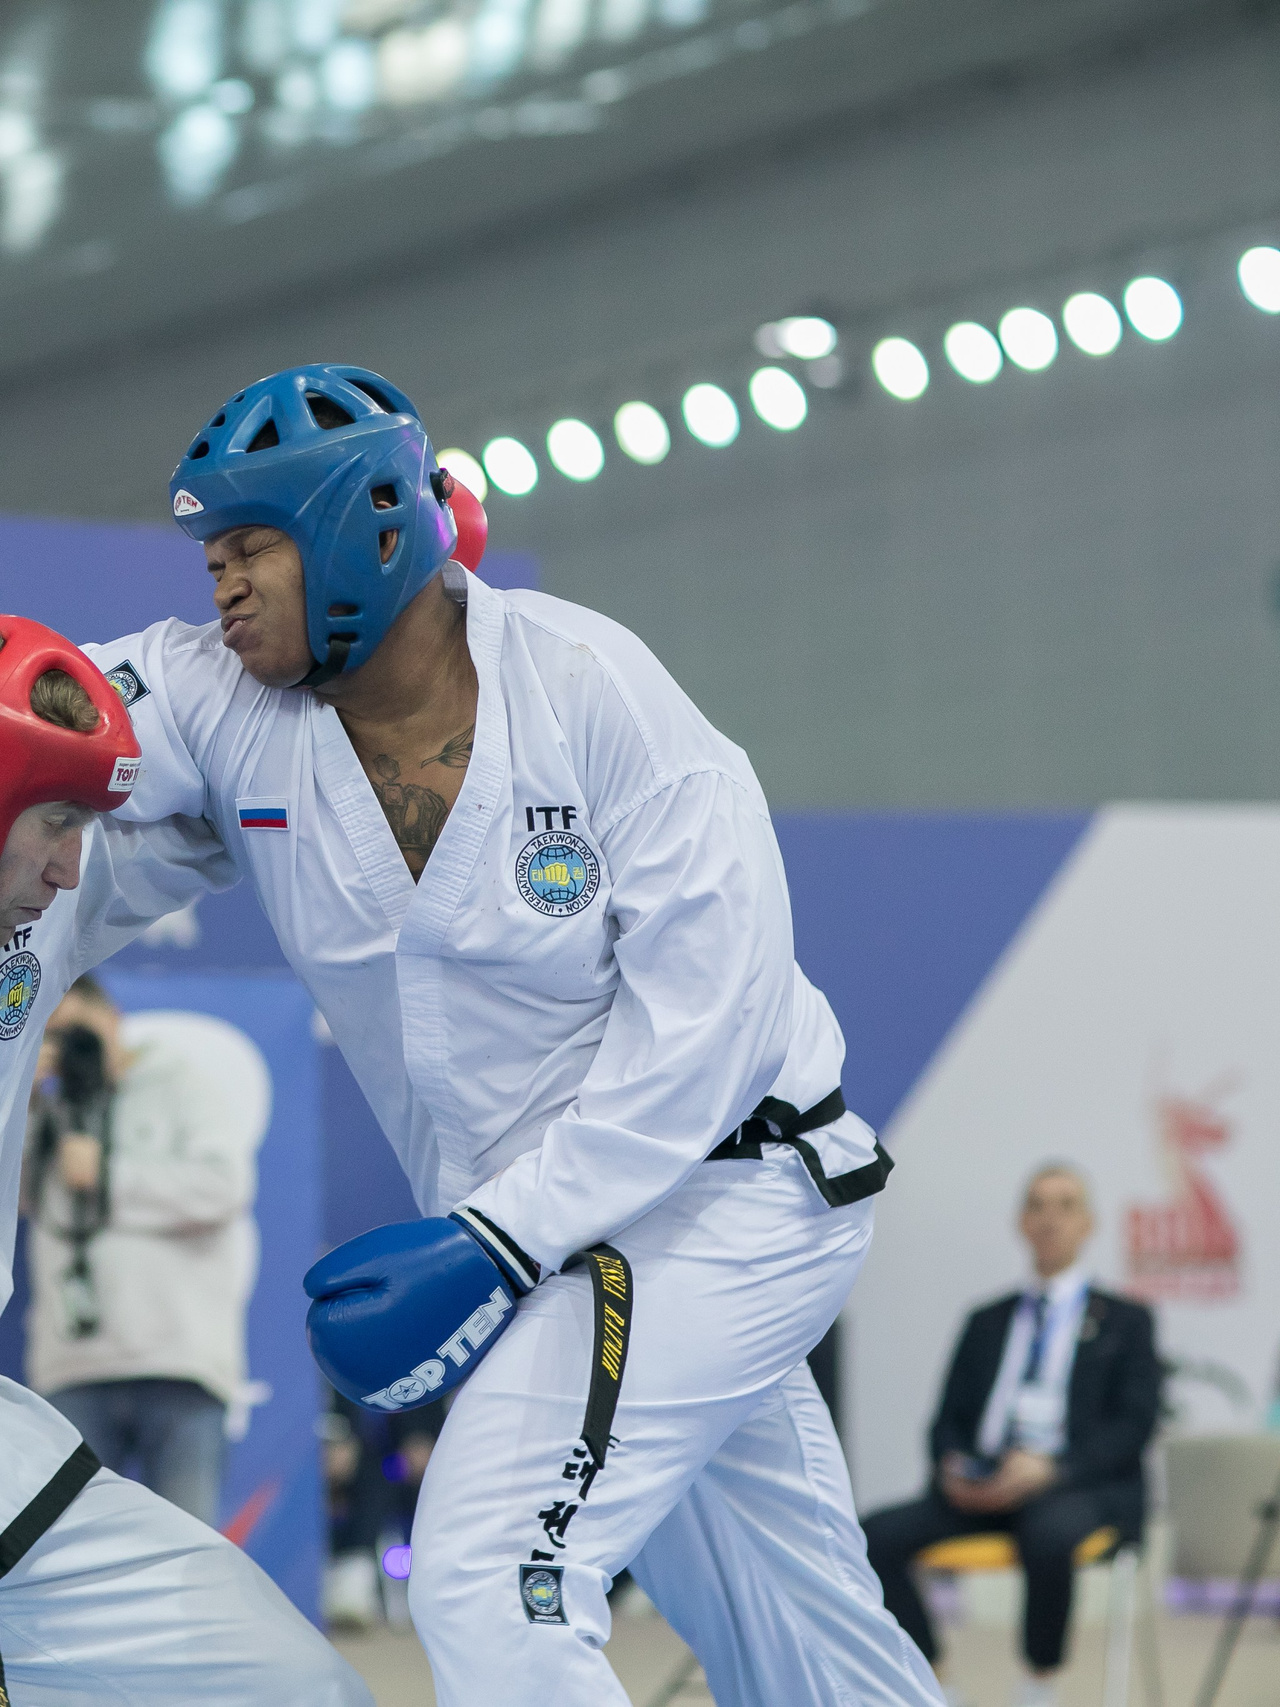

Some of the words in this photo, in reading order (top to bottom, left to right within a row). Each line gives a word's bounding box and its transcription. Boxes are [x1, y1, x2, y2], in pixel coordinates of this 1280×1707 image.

[525, 805, 577, 832] ITF
[531, 833, 592, 861] TAEKWON-DO
[518, 851, 555, 914] INTERNATIONAL
[565, 862, 597, 914] FEDERATION
[592, 1253, 626, 1301] RUSSIA
[361, 1358, 446, 1411] TOP
[435, 1285, 513, 1367] TEN
[601, 1302, 625, 1381] RATMIR
